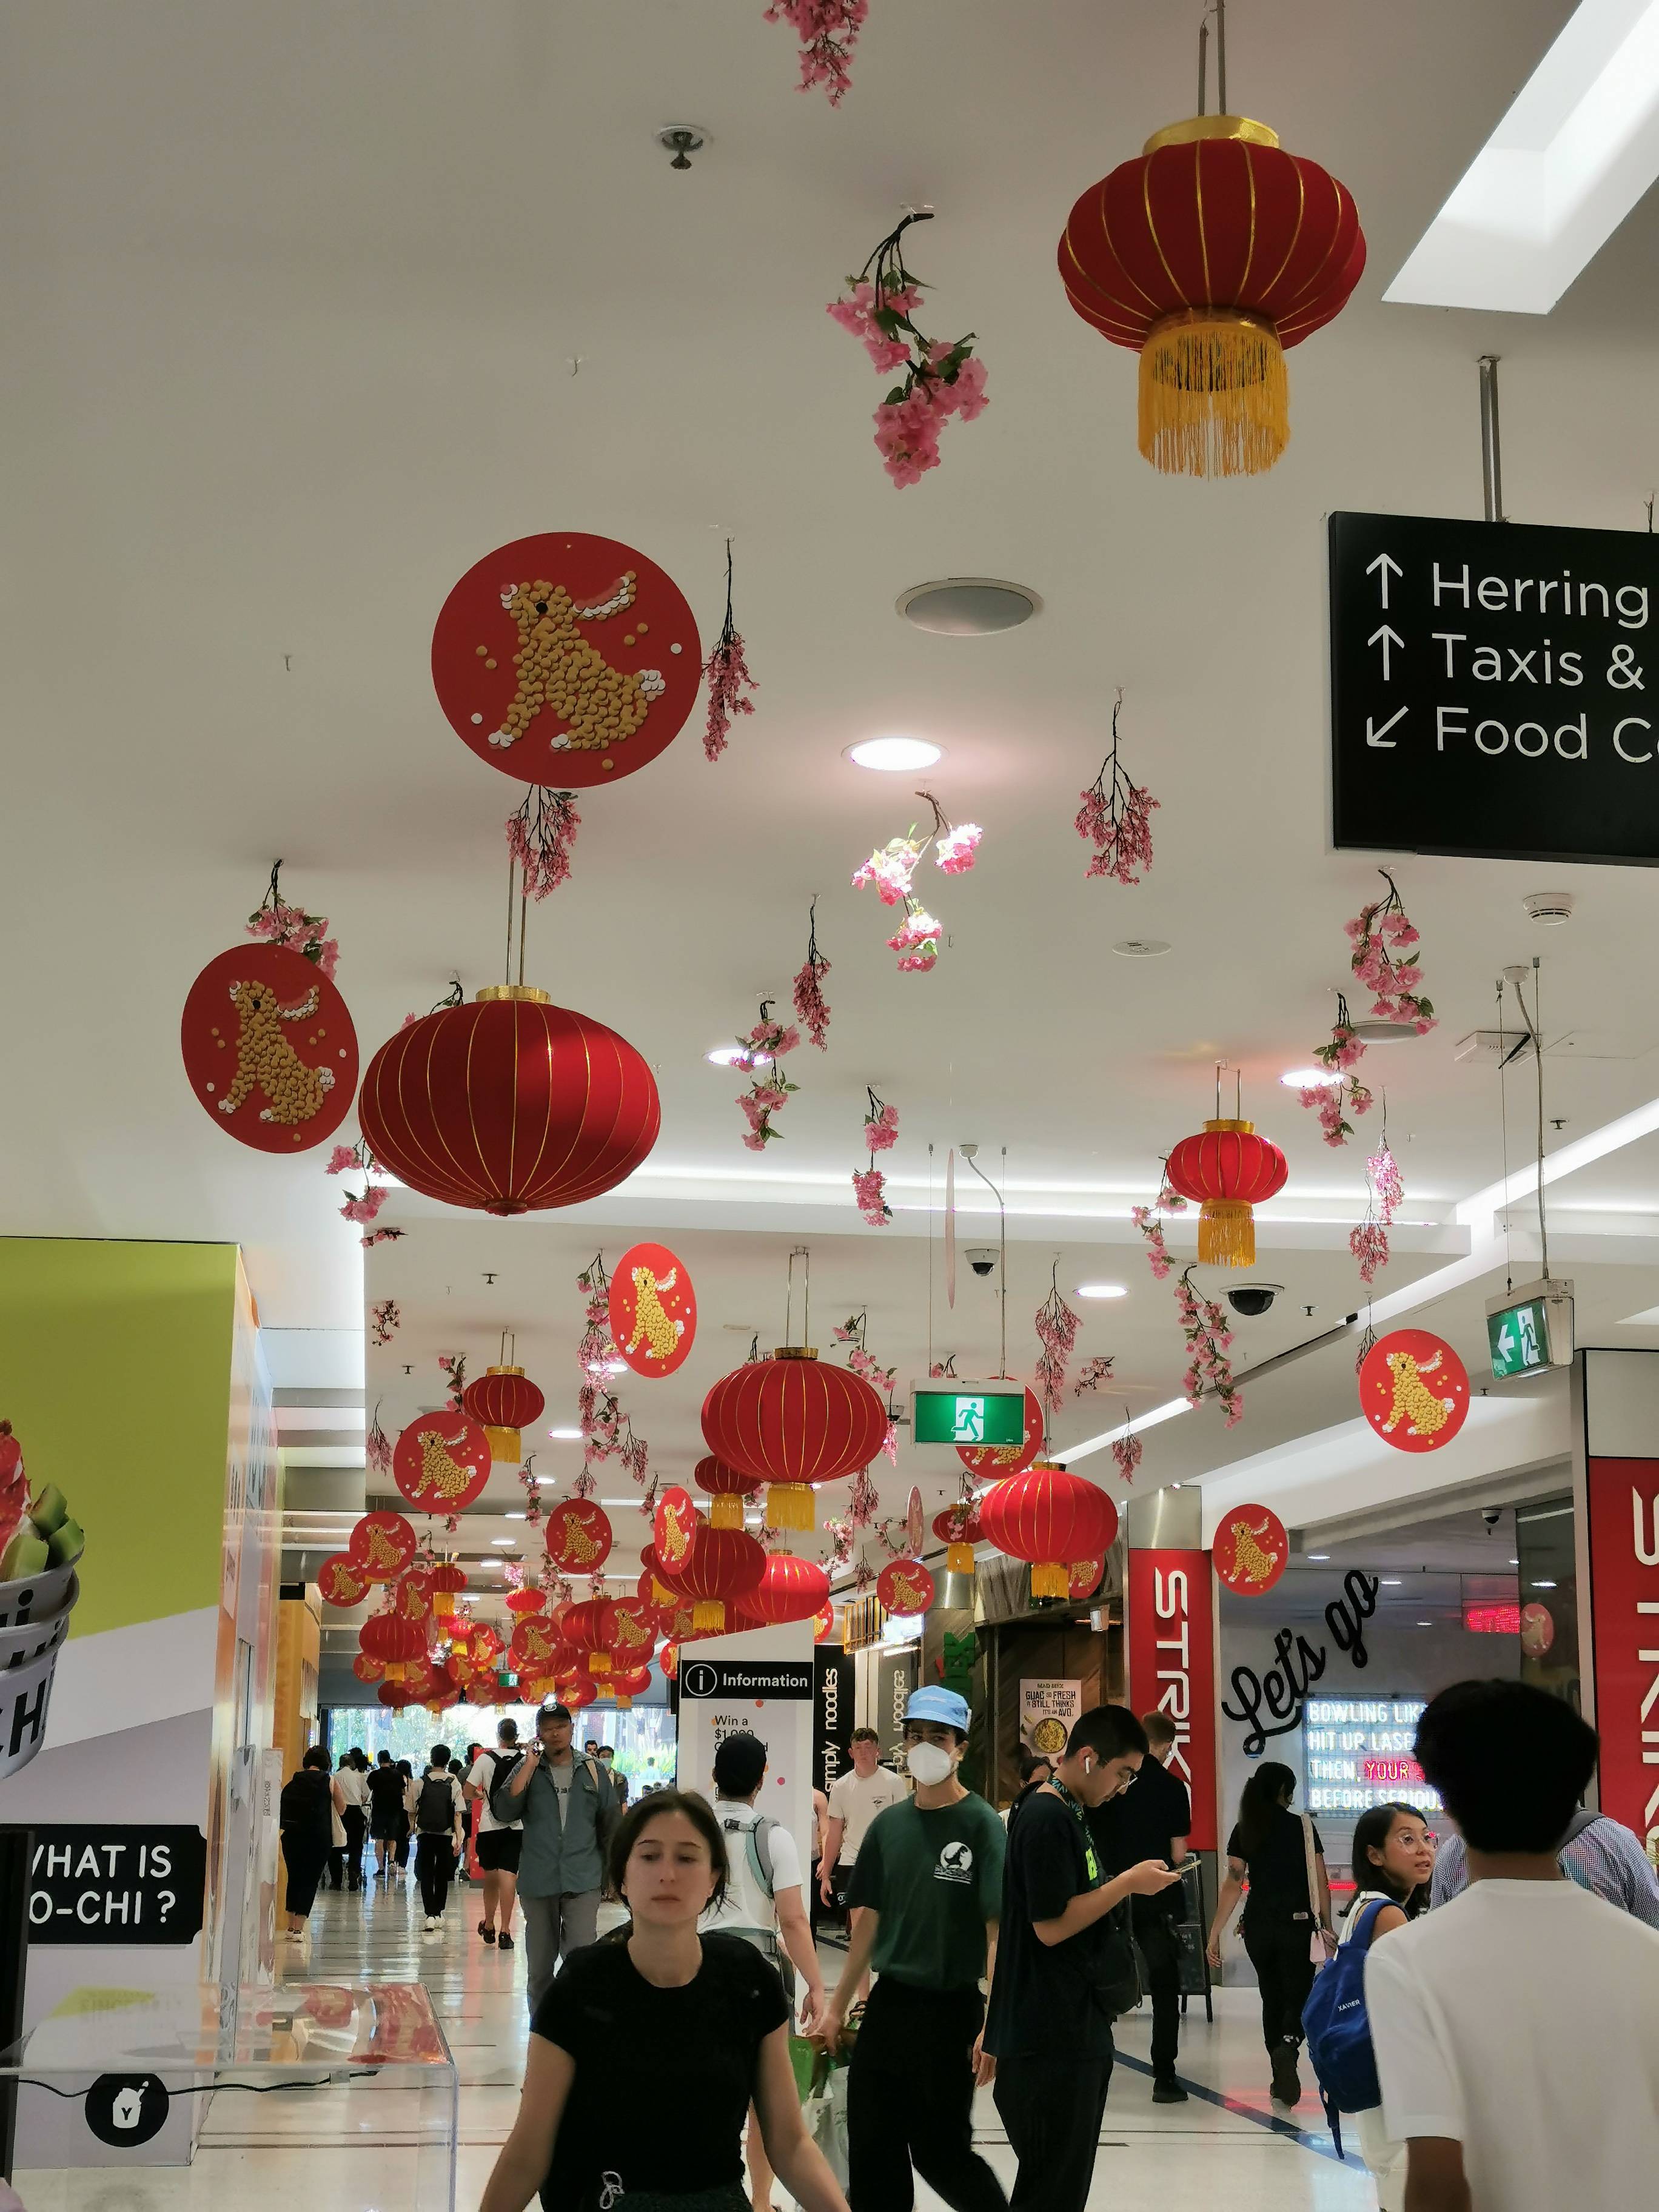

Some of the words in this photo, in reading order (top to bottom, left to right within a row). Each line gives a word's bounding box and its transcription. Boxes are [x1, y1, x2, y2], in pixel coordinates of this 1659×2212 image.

[1433, 562, 1649, 629] Herring
[1432, 632, 1584, 687] Taxis
[1606, 644, 1646, 691] &
[1436, 706, 1587, 760] Food
[1613, 717, 1659, 763] C
[1221, 1627, 1326, 1758] Let's
[1325, 1569, 1379, 1669] go
[723, 1672, 808, 1687] Information
[822, 1668, 838, 1730] noodles
[1025, 1691, 1045, 1700] GUAC
[1053, 1691, 1076, 1700] FRESH
[1031, 1700, 1050, 1708] STILL
[1051, 1700, 1074, 1708] THINKS
[1155, 1566, 1192, 1820] STRIK
[714, 1715, 739, 1726] Win
[742, 1718, 748, 1726] a
[1307, 1701, 1389, 1724] BOWLING
[1393, 1701, 1427, 1723] LIK
[1307, 1731, 1336, 1752] HIT
[1342, 1731, 1365, 1751] UP
[1371, 1731, 1417, 1752] LASE
[1364, 1760, 1410, 1781] YOUR
[1312, 1789, 1373, 1809] BEFORE
[139, 1845, 172, 1879] IS
[29, 1890, 142, 1925] O-CHI
[157, 1890, 176, 1923] ?
[1338, 1999, 1361, 2012] XAVIER
